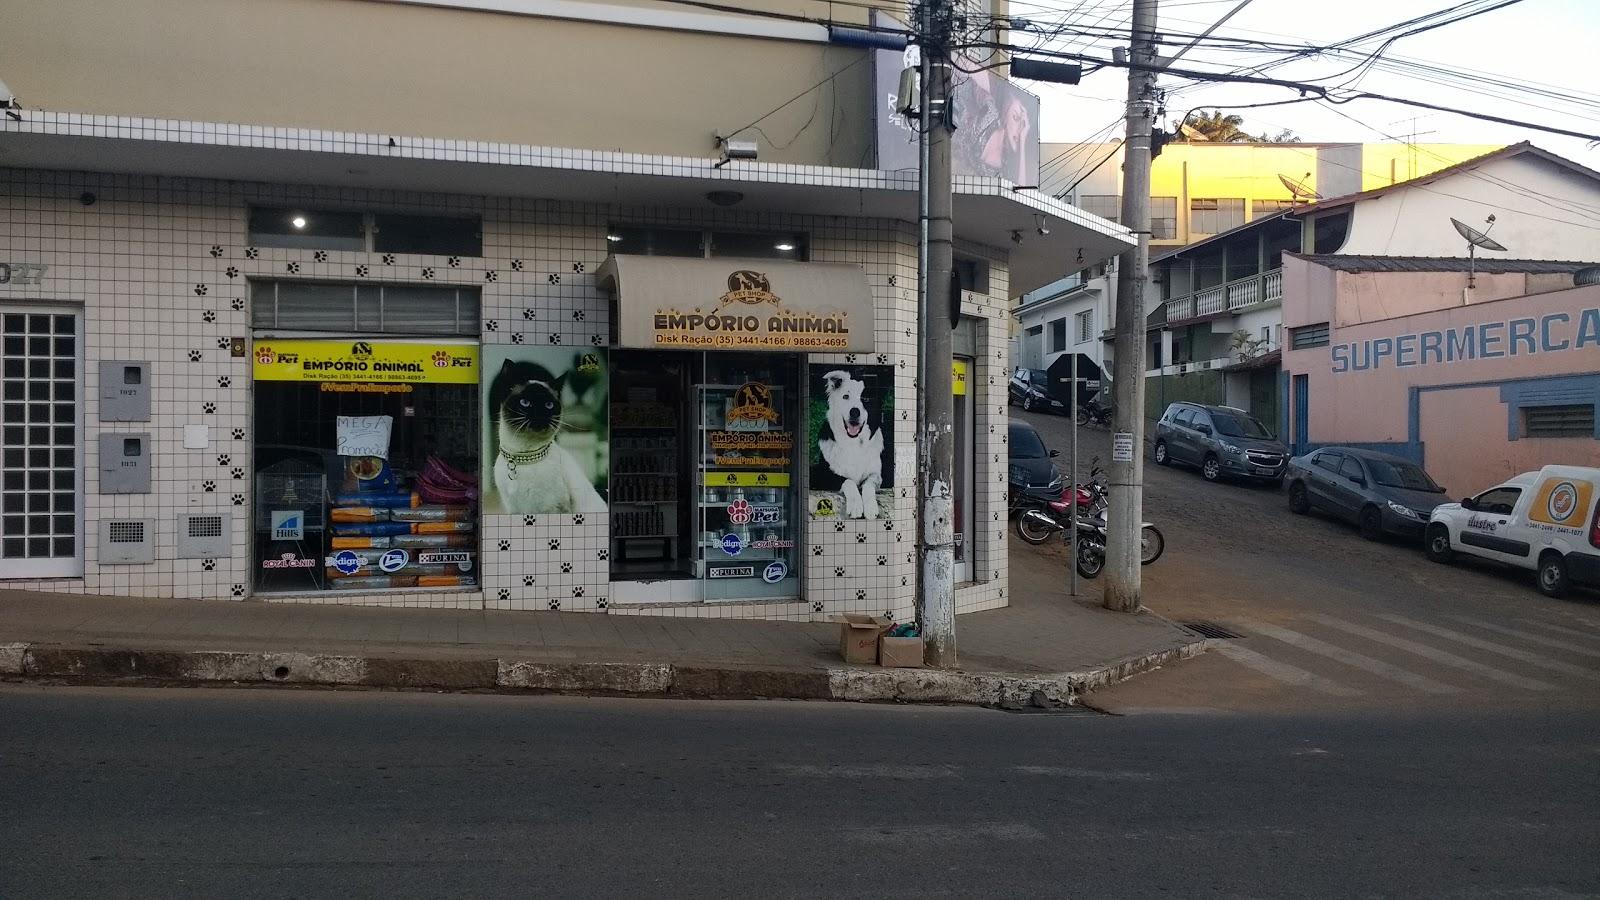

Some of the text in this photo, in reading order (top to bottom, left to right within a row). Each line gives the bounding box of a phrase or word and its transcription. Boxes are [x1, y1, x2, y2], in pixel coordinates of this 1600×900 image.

[655, 308, 849, 334] EMPÓRIO ANIMAL
[657, 335, 678, 343] Disk
[682, 335, 713, 345] Ração
[716, 336, 734, 346] (35)
[737, 336, 786, 345] 3441-4166
[794, 338, 847, 347] 98863-4695
[1331, 308, 1600, 373] SUPERMERCA
[304, 357, 368, 371] EMPÓRIO
[373, 362, 424, 372] ANIMAL
[712, 432, 756, 442] EMPÓRIO
[753, 512, 779, 521] Pet
[276, 529, 299, 538] Hill's
[263, 558, 316, 568] ROYAL CANIN
[430, 554, 466, 562] PURINA
[720, 568, 751, 576] PURINA
